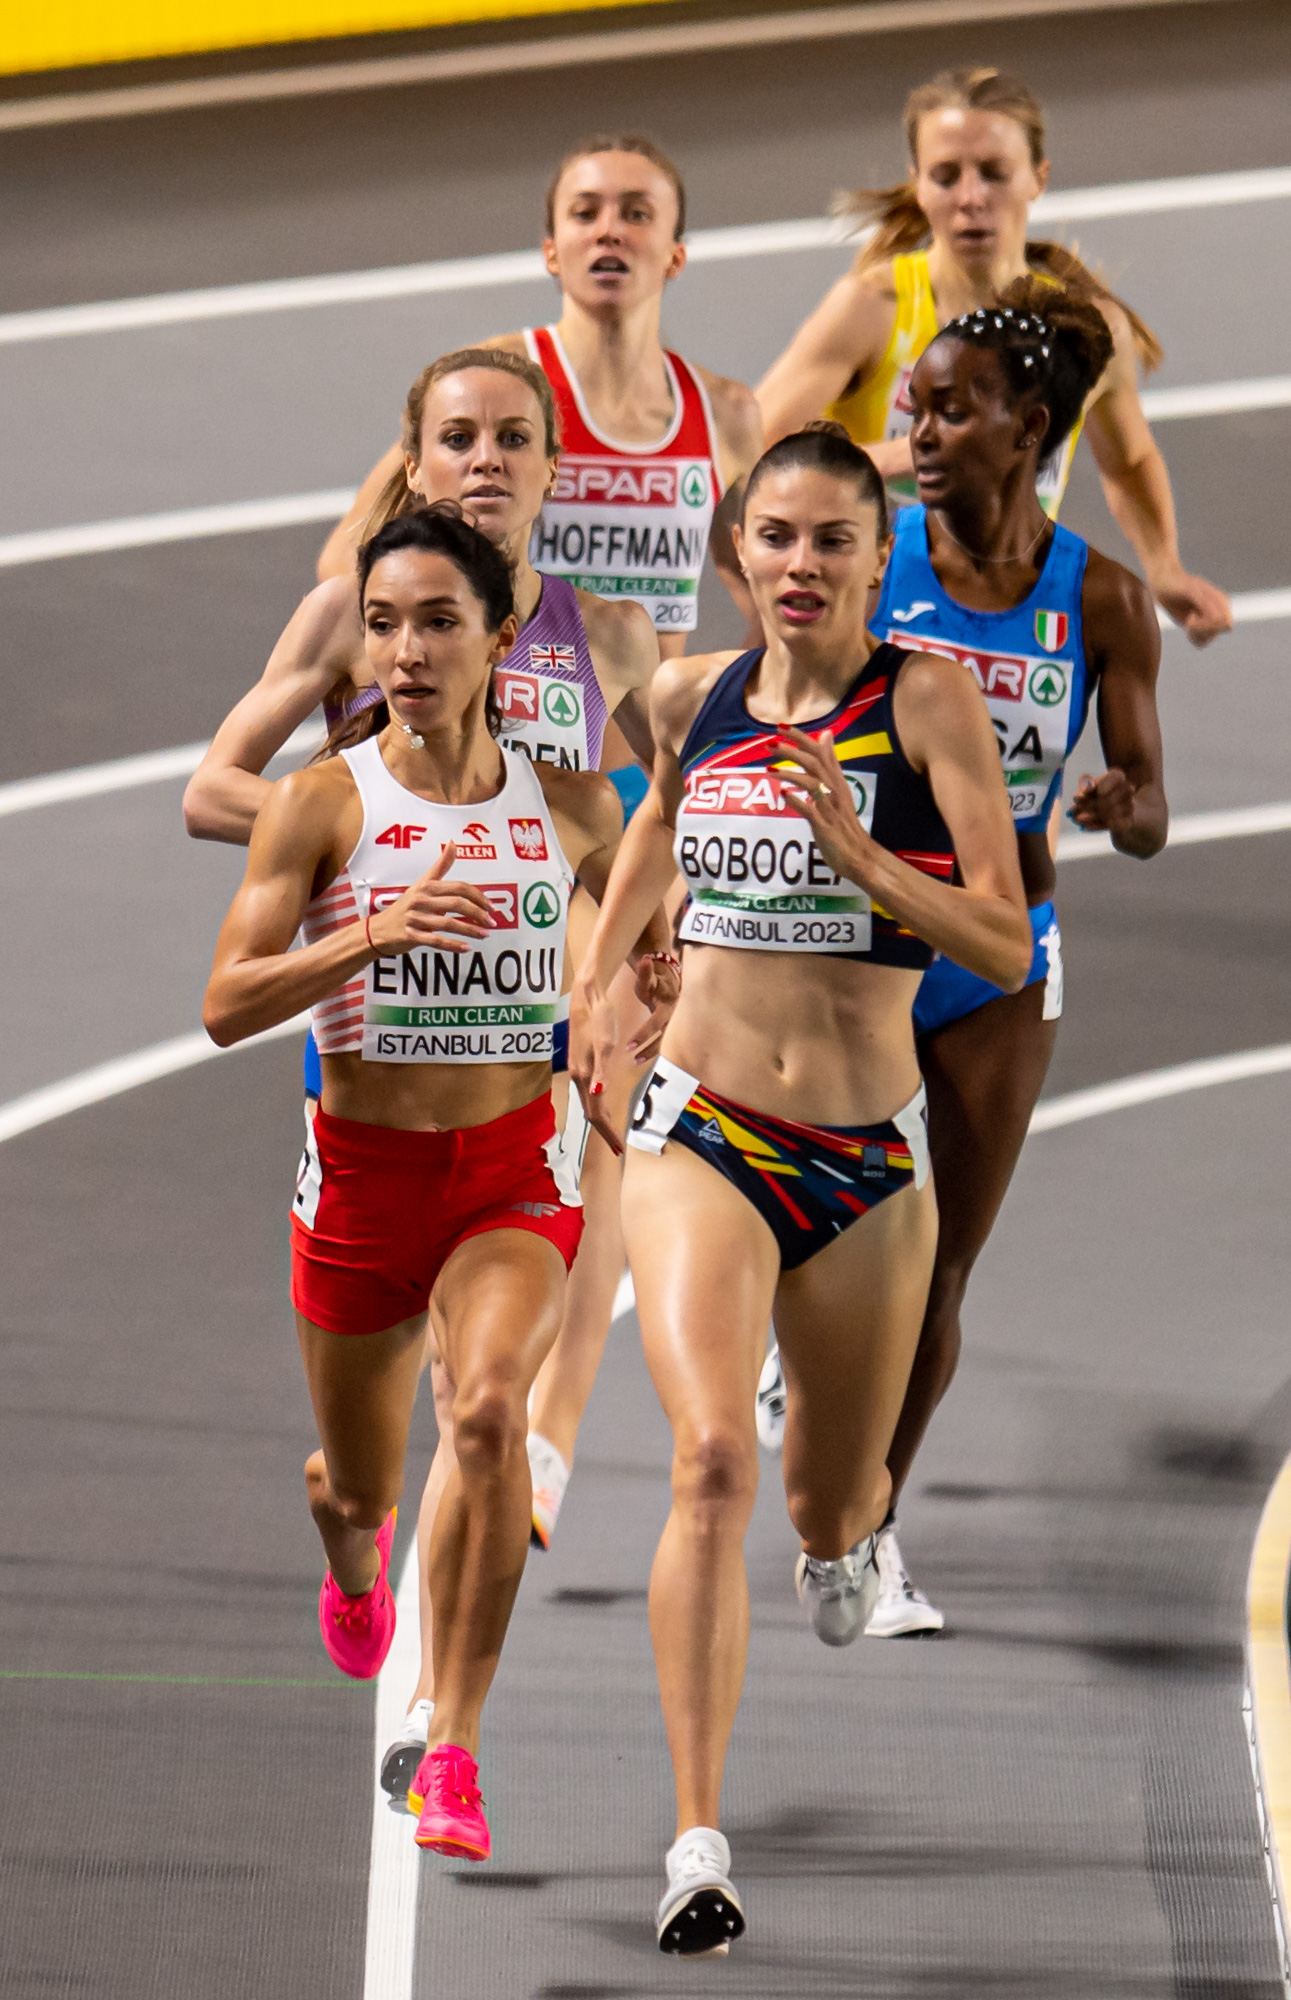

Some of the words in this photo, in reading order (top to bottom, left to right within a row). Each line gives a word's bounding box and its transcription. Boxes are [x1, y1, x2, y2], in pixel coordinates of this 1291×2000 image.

[554, 465, 675, 502] SPAR
[621, 580, 678, 594] CLEAN
[375, 824, 428, 849] 4F
[456, 846, 494, 858] RLEN
[680, 836, 843, 886] BOBOCE
[752, 896, 817, 911] CLEAN
[690, 911, 788, 943] ISTANBUL
[792, 921, 856, 944] 2023
[372, 946, 557, 997] ENNAOUI
[408, 1009, 413, 1024] I
[418, 1008, 459, 1025] RUN
[377, 1032, 497, 1056] ISTANBUL
